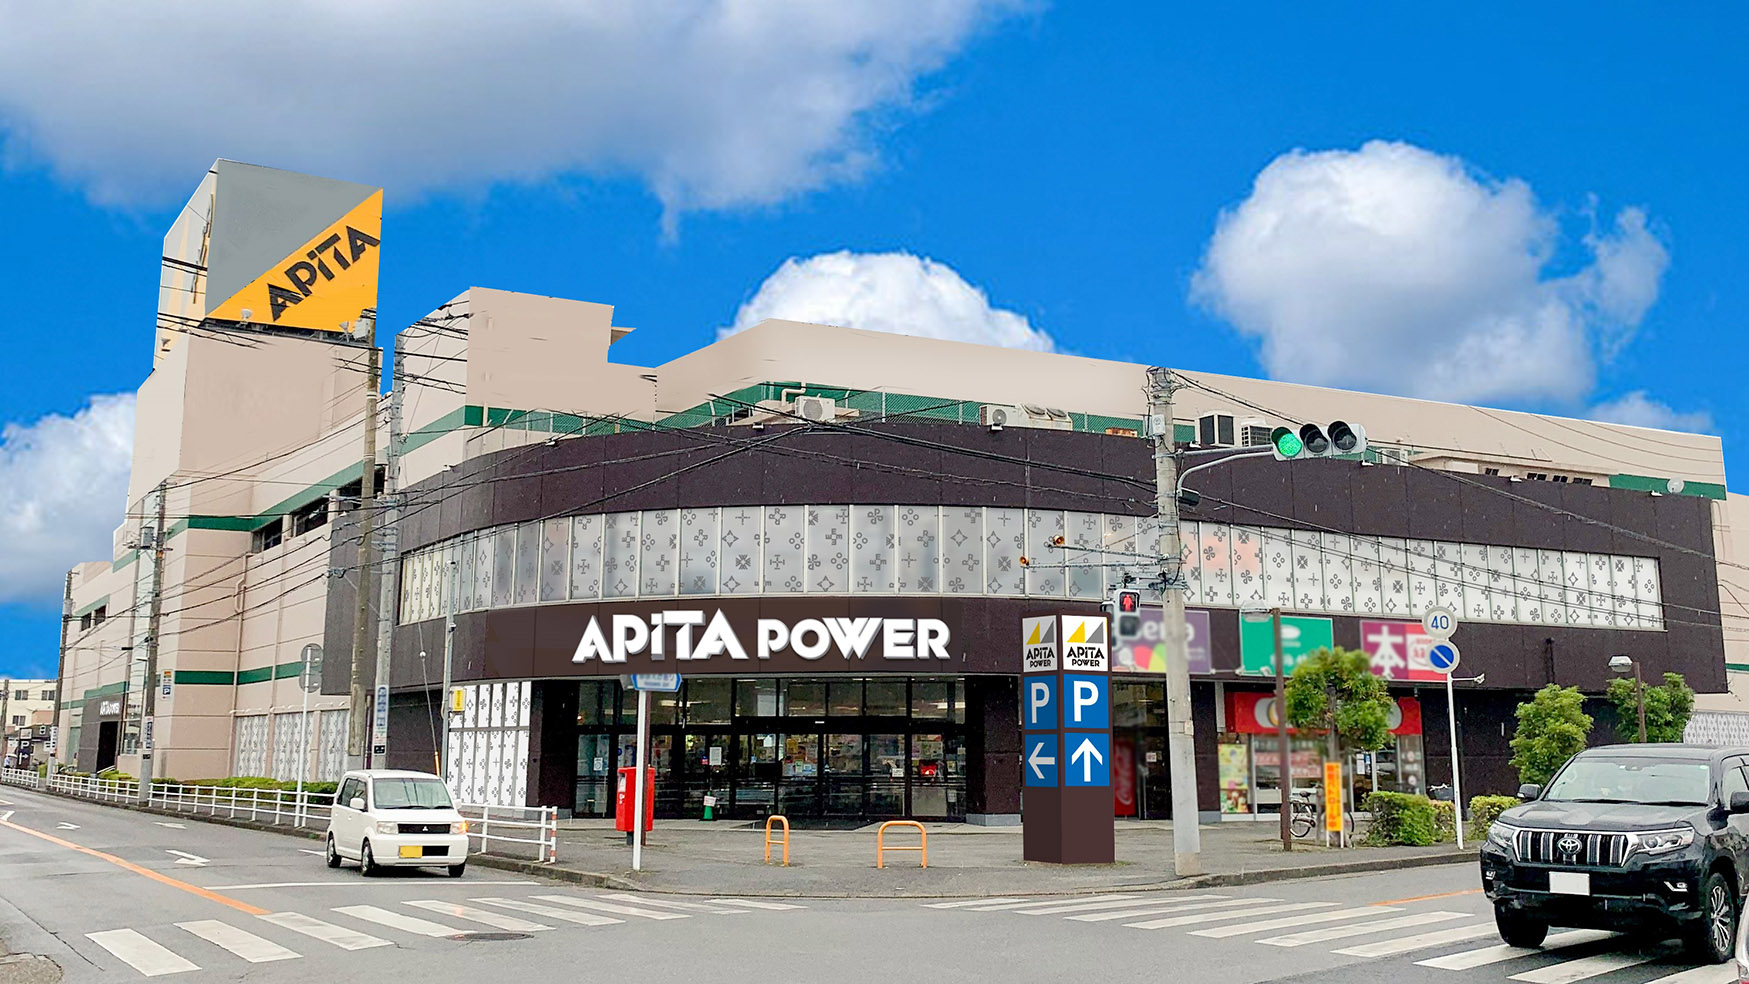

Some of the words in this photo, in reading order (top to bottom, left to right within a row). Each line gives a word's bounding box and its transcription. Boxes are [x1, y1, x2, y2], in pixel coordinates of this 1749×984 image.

[1431, 615, 1450, 630] 40
[757, 616, 952, 661] POWER
[1367, 625, 1405, 679] 本
[1029, 659, 1052, 668] POWER
[1071, 659, 1101, 668] POWER
[1031, 682, 1050, 724] P
[1073, 680, 1099, 722] P
[20, 741, 30, 750] P
